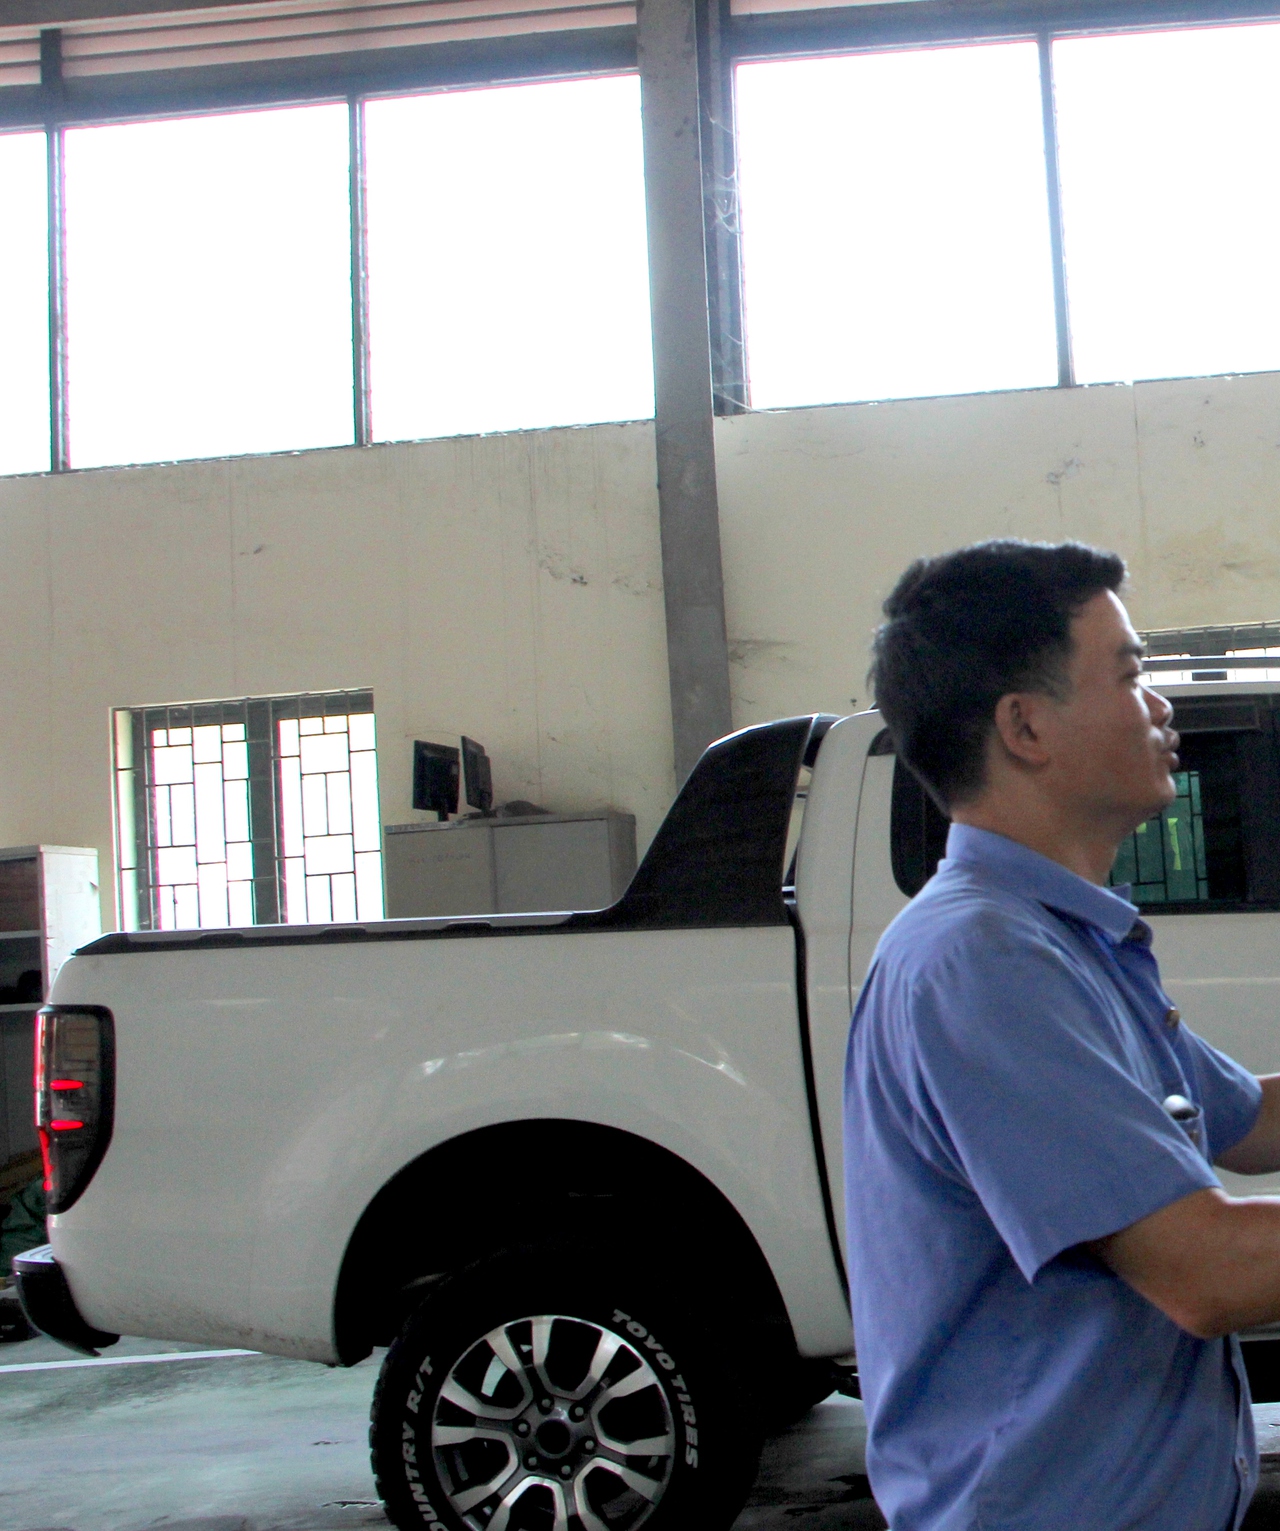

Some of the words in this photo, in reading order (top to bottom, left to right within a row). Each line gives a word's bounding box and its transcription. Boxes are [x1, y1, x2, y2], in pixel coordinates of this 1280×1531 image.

[405, 1355, 434, 1414] R/T
[611, 1308, 676, 1371] TOYO
[671, 1374, 699, 1469] TIRES
